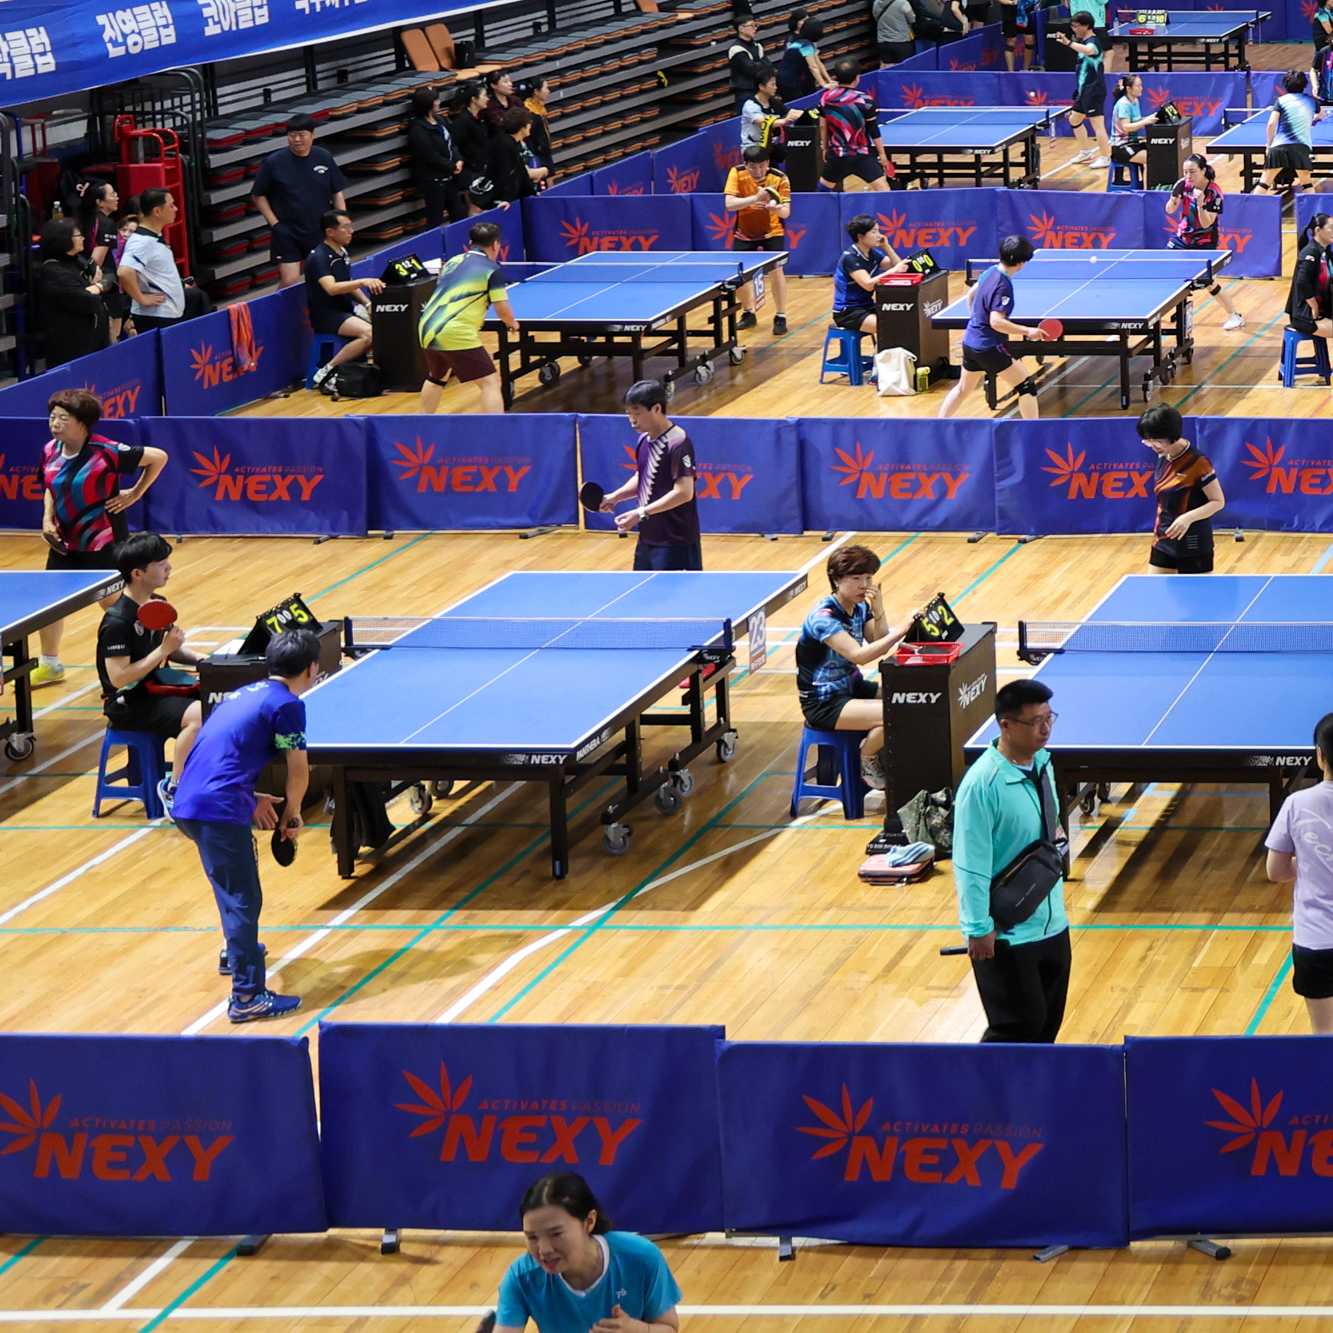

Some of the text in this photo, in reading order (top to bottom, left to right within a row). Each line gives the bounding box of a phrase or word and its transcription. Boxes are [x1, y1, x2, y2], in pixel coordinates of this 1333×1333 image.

[96, 1, 176, 58] 진영클럽
[892, 226, 977, 248] NEXY
[375, 304, 408, 312] NEXY
[215, 474, 325, 501] NEXY
[416, 466, 531, 492] NEXY
[856, 472, 969, 499] NEXY
[266, 603, 309, 634] 7 5
[750, 610, 766, 651] 23
[891, 692, 942, 704] NEXY
[530, 754, 568, 765] NEXY
[68, 1117, 232, 1132] ACTIVATES PASSION
[440, 1115, 643, 1166] NEXY
[33, 1132, 235, 1182] NEXY
[844, 1136, 1045, 1190] NEXY
